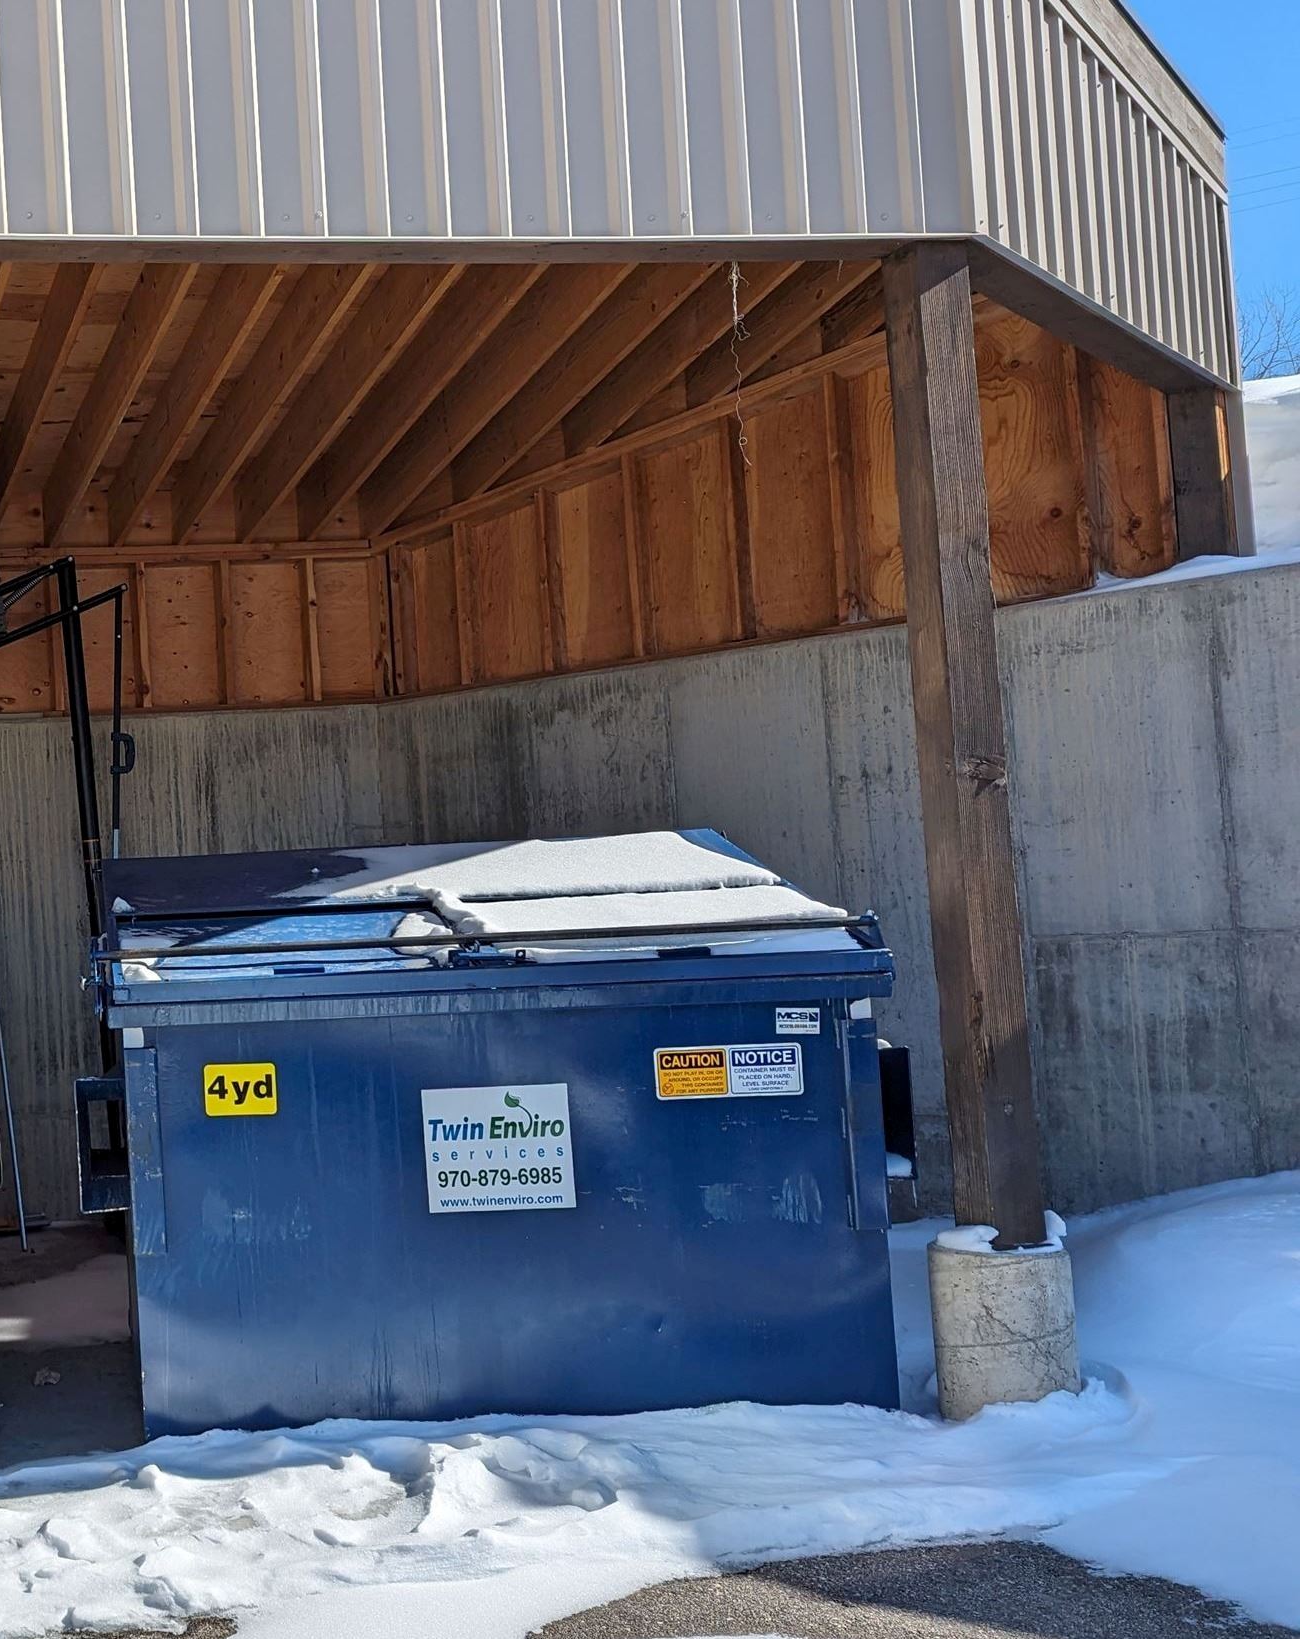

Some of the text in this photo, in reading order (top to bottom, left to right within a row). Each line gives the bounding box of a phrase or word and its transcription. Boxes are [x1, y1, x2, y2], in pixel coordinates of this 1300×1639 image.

[777, 1011, 808, 1020] MCS
[662, 1054, 720, 1068] CAUTION
[734, 1050, 793, 1065] NOTICE
[207, 1073, 273, 1105] 4yd
[428, 1113, 565, 1141] Twin Enviro
[438, 1167, 562, 1188] 970-879-6985
[440, 1194, 563, 1207] www.twinenviro.com
